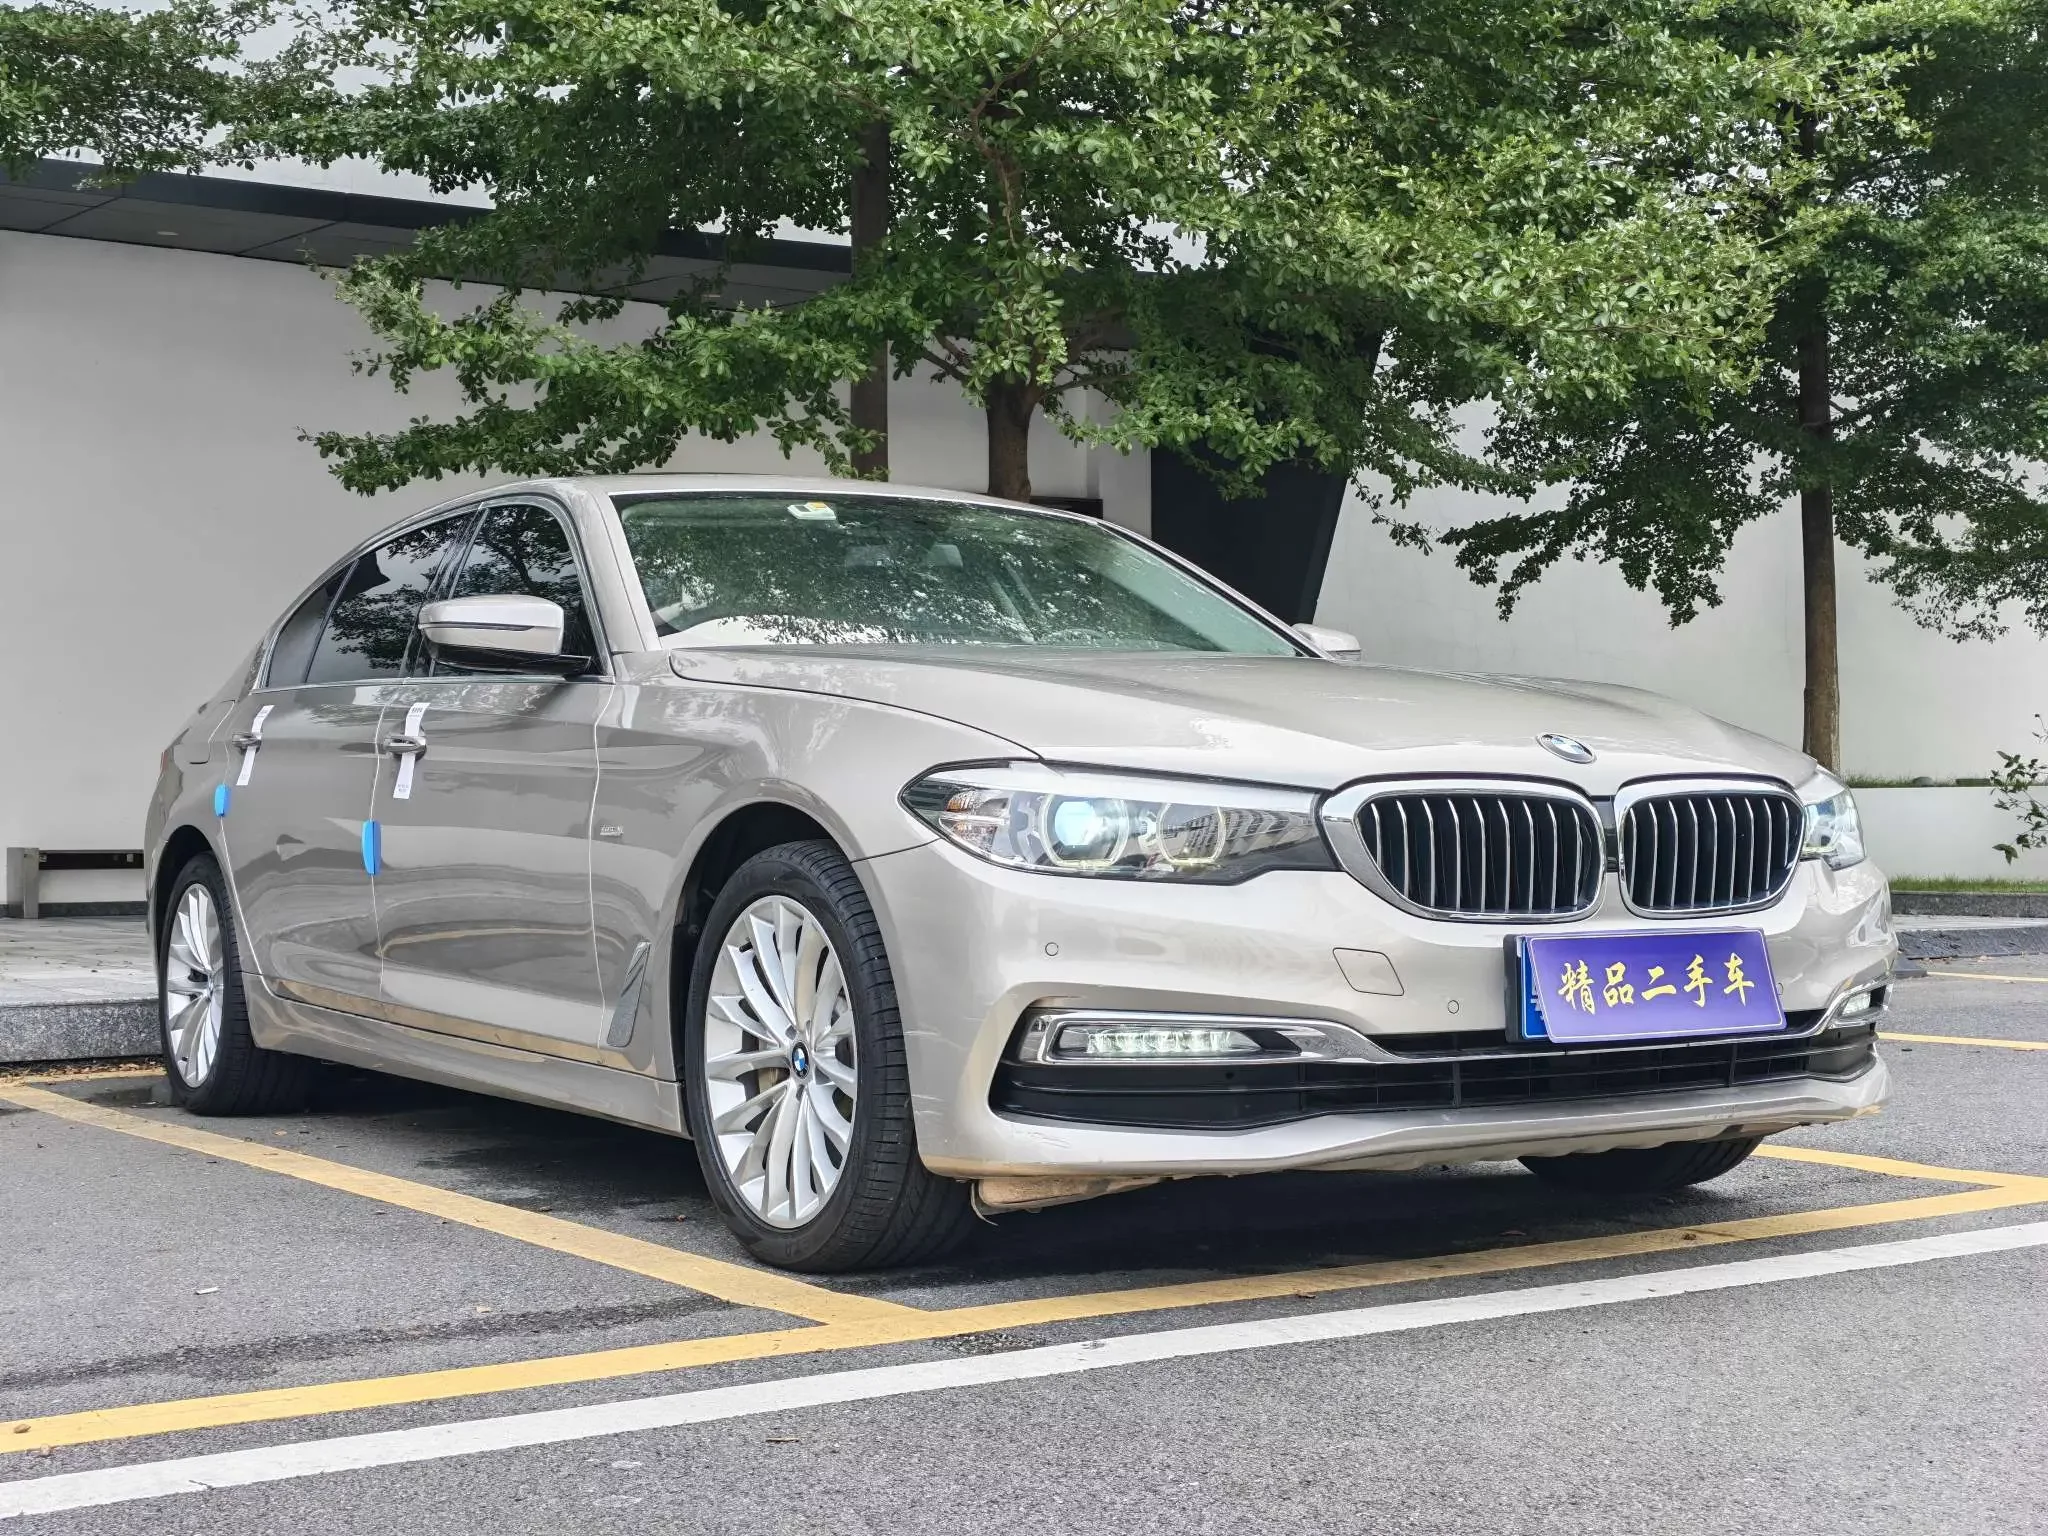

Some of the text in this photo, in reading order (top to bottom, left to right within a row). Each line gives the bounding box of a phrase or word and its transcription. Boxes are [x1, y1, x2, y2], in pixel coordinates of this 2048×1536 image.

[1558, 952, 1755, 1014] 精品二手车
